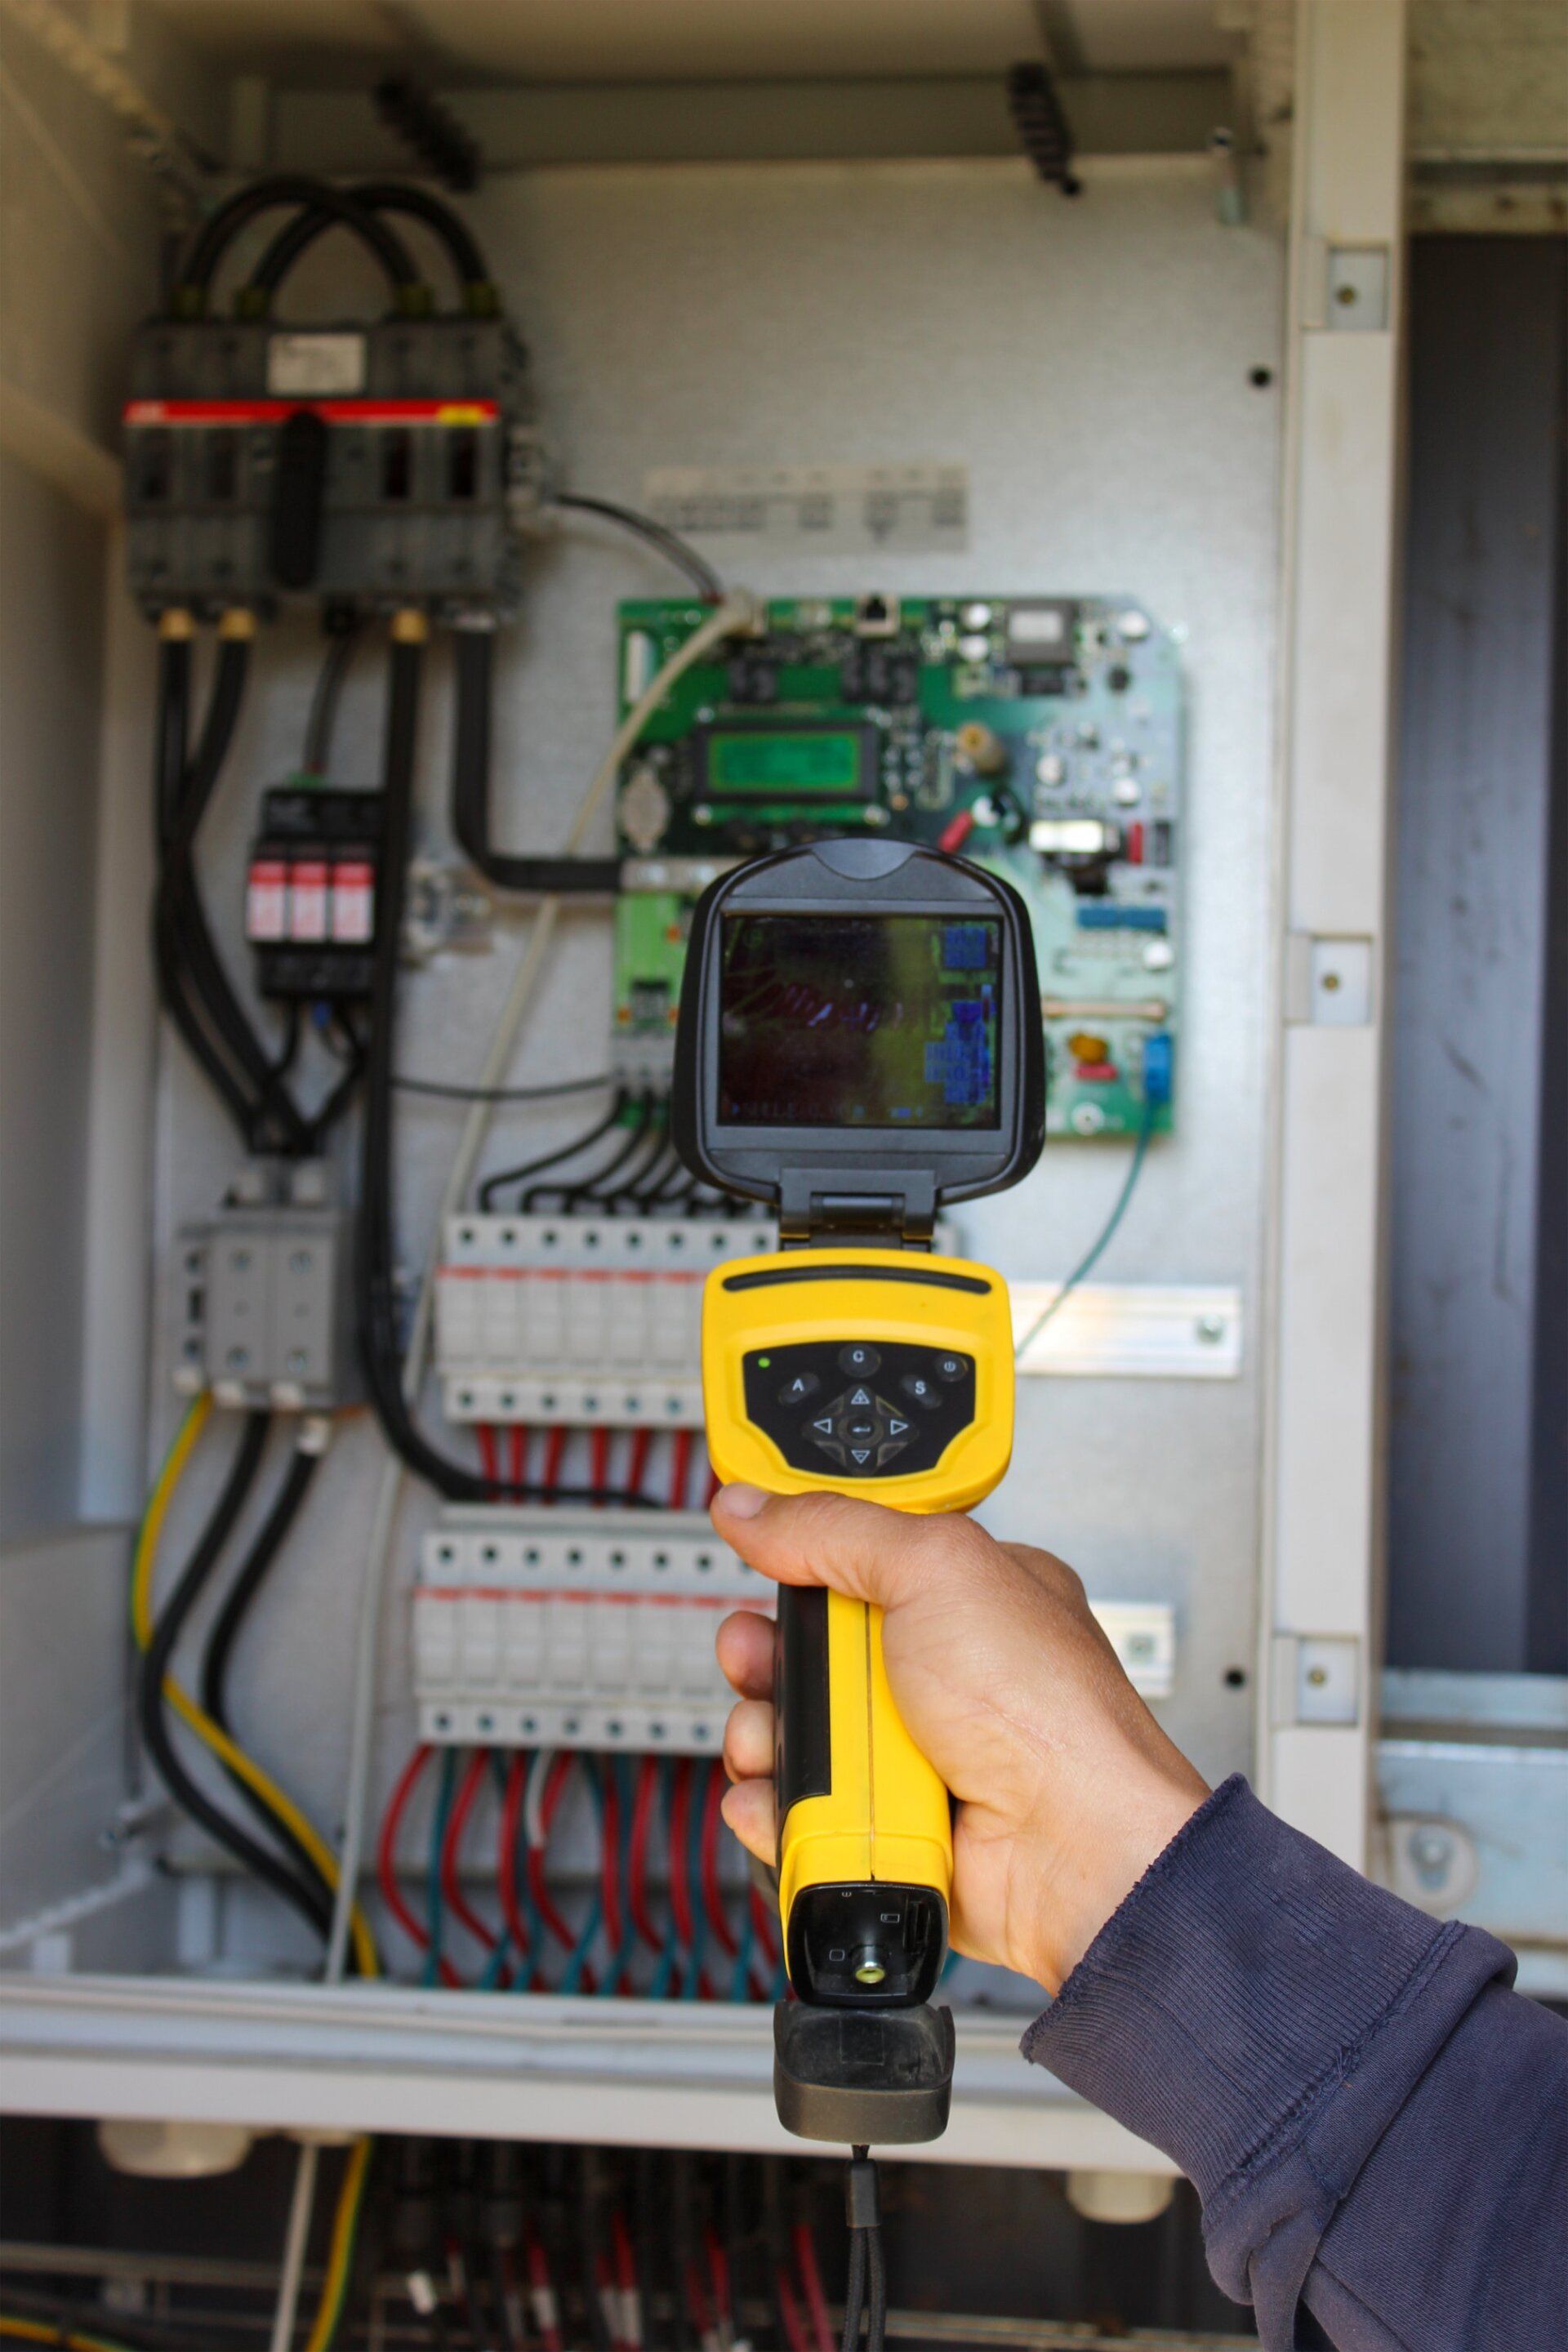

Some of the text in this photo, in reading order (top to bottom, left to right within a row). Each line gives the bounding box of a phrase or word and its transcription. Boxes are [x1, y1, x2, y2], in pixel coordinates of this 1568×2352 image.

[853, 1350, 864, 1363] C
[792, 1378, 804, 1392] A
[915, 1380, 926, 1395] S
